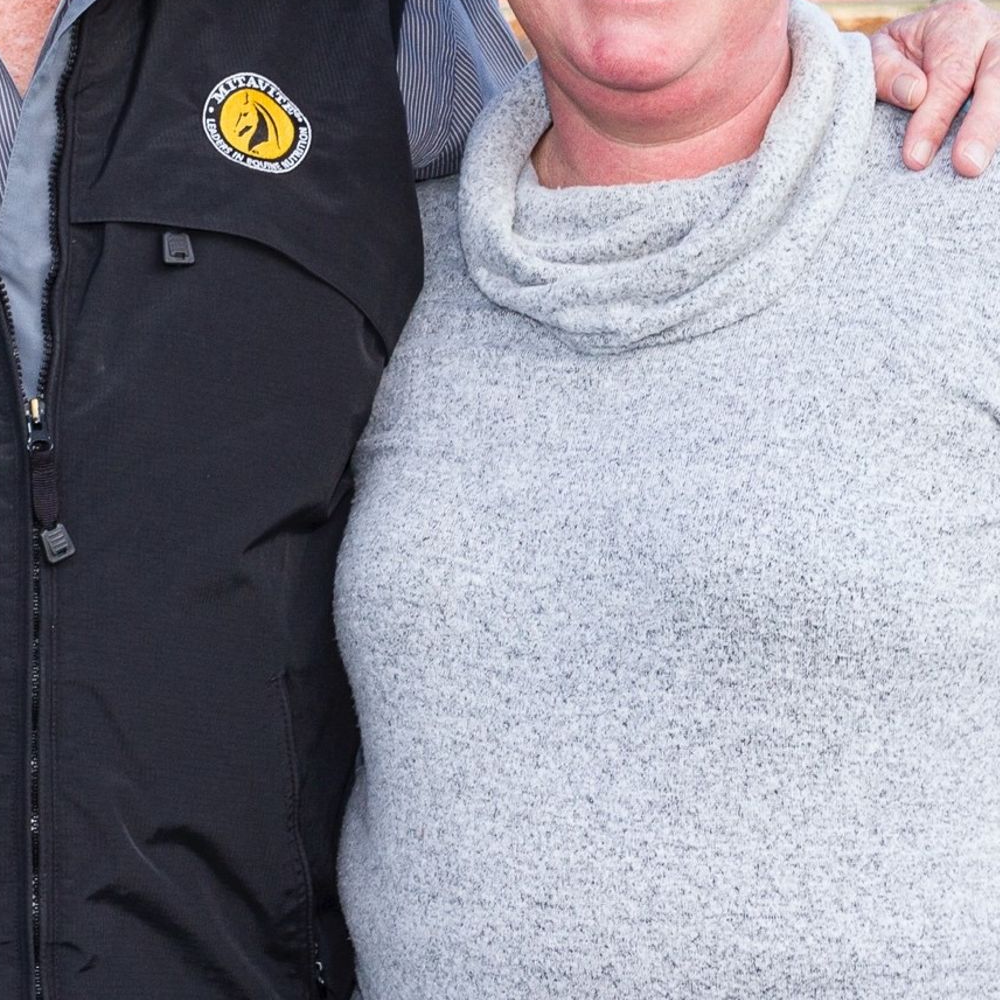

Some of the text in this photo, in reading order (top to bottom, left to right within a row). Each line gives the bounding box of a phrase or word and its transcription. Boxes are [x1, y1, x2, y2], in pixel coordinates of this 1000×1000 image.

[207, 119, 232, 153] LEADERS
[231, 151, 244, 162] IN
[280, 127, 308, 169] NUTRITION
